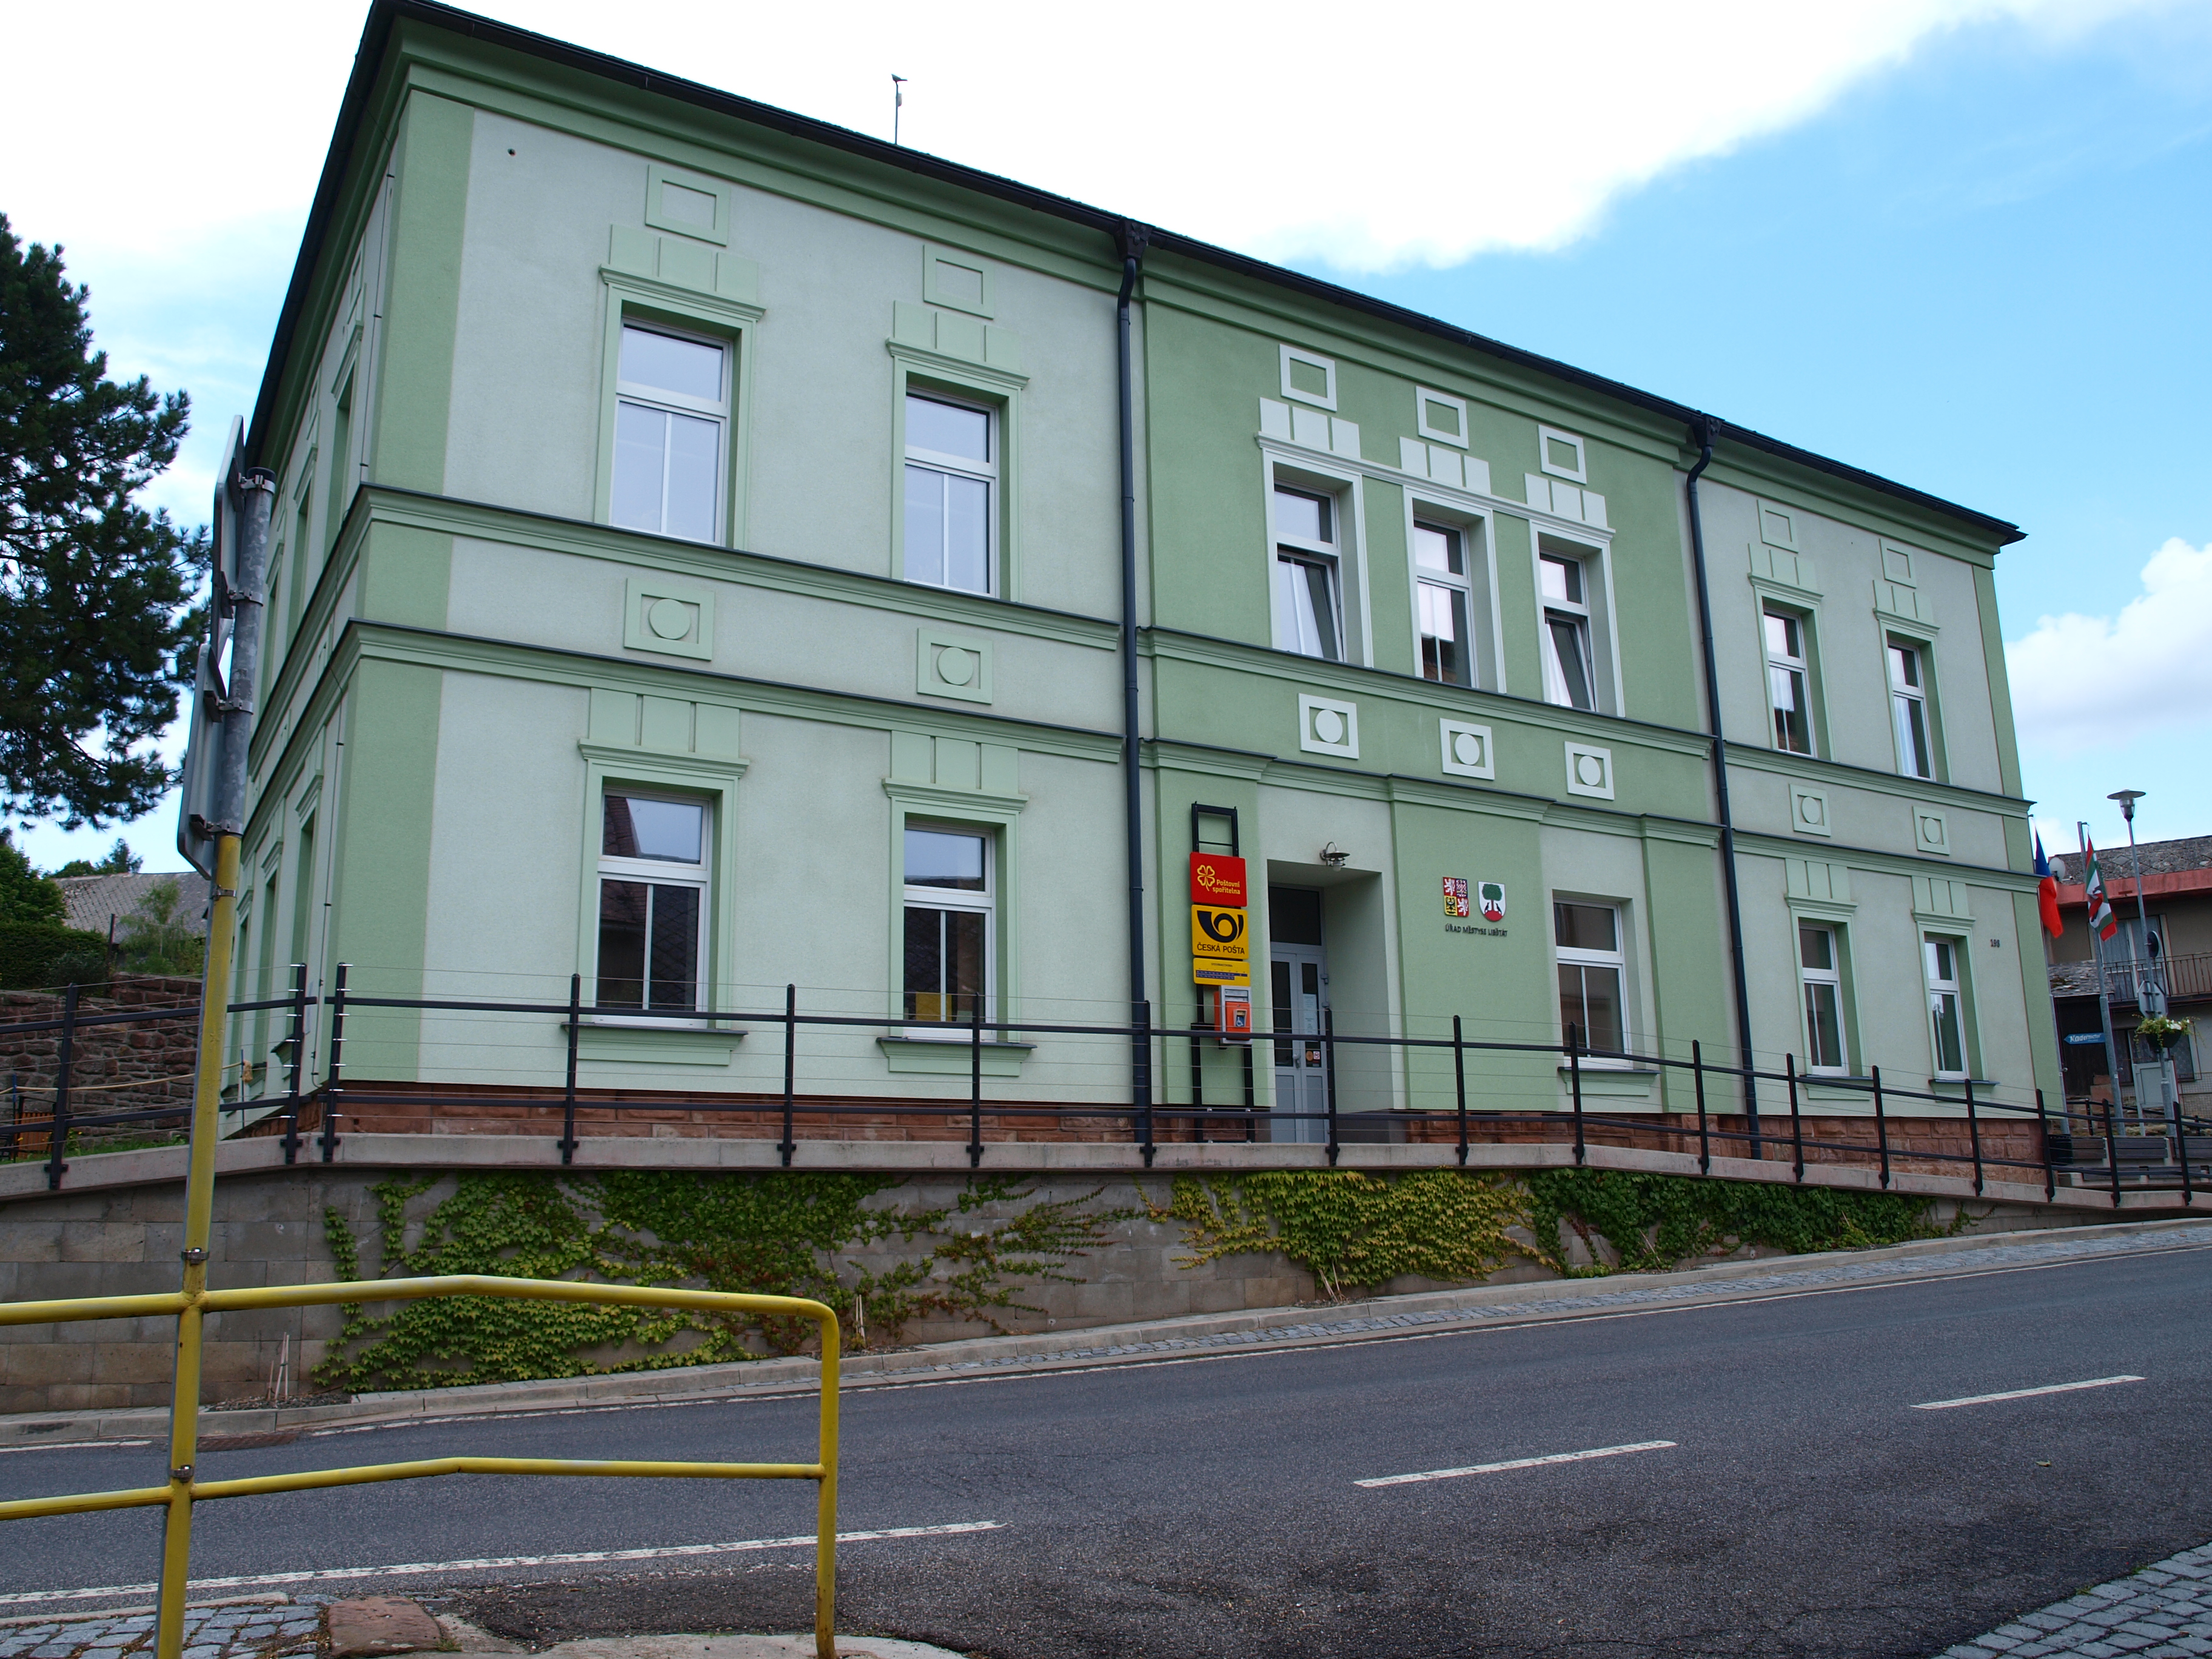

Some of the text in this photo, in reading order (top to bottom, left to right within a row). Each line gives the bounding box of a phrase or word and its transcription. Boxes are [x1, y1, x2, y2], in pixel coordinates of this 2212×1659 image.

[1216, 879, 1240, 888] Poštovní
[1212, 886, 1241, 895] spořitelna
[1445, 923, 1461, 933] ÚŘAD
[1197, 941, 1245, 954] ČESKÁ POŠTA
